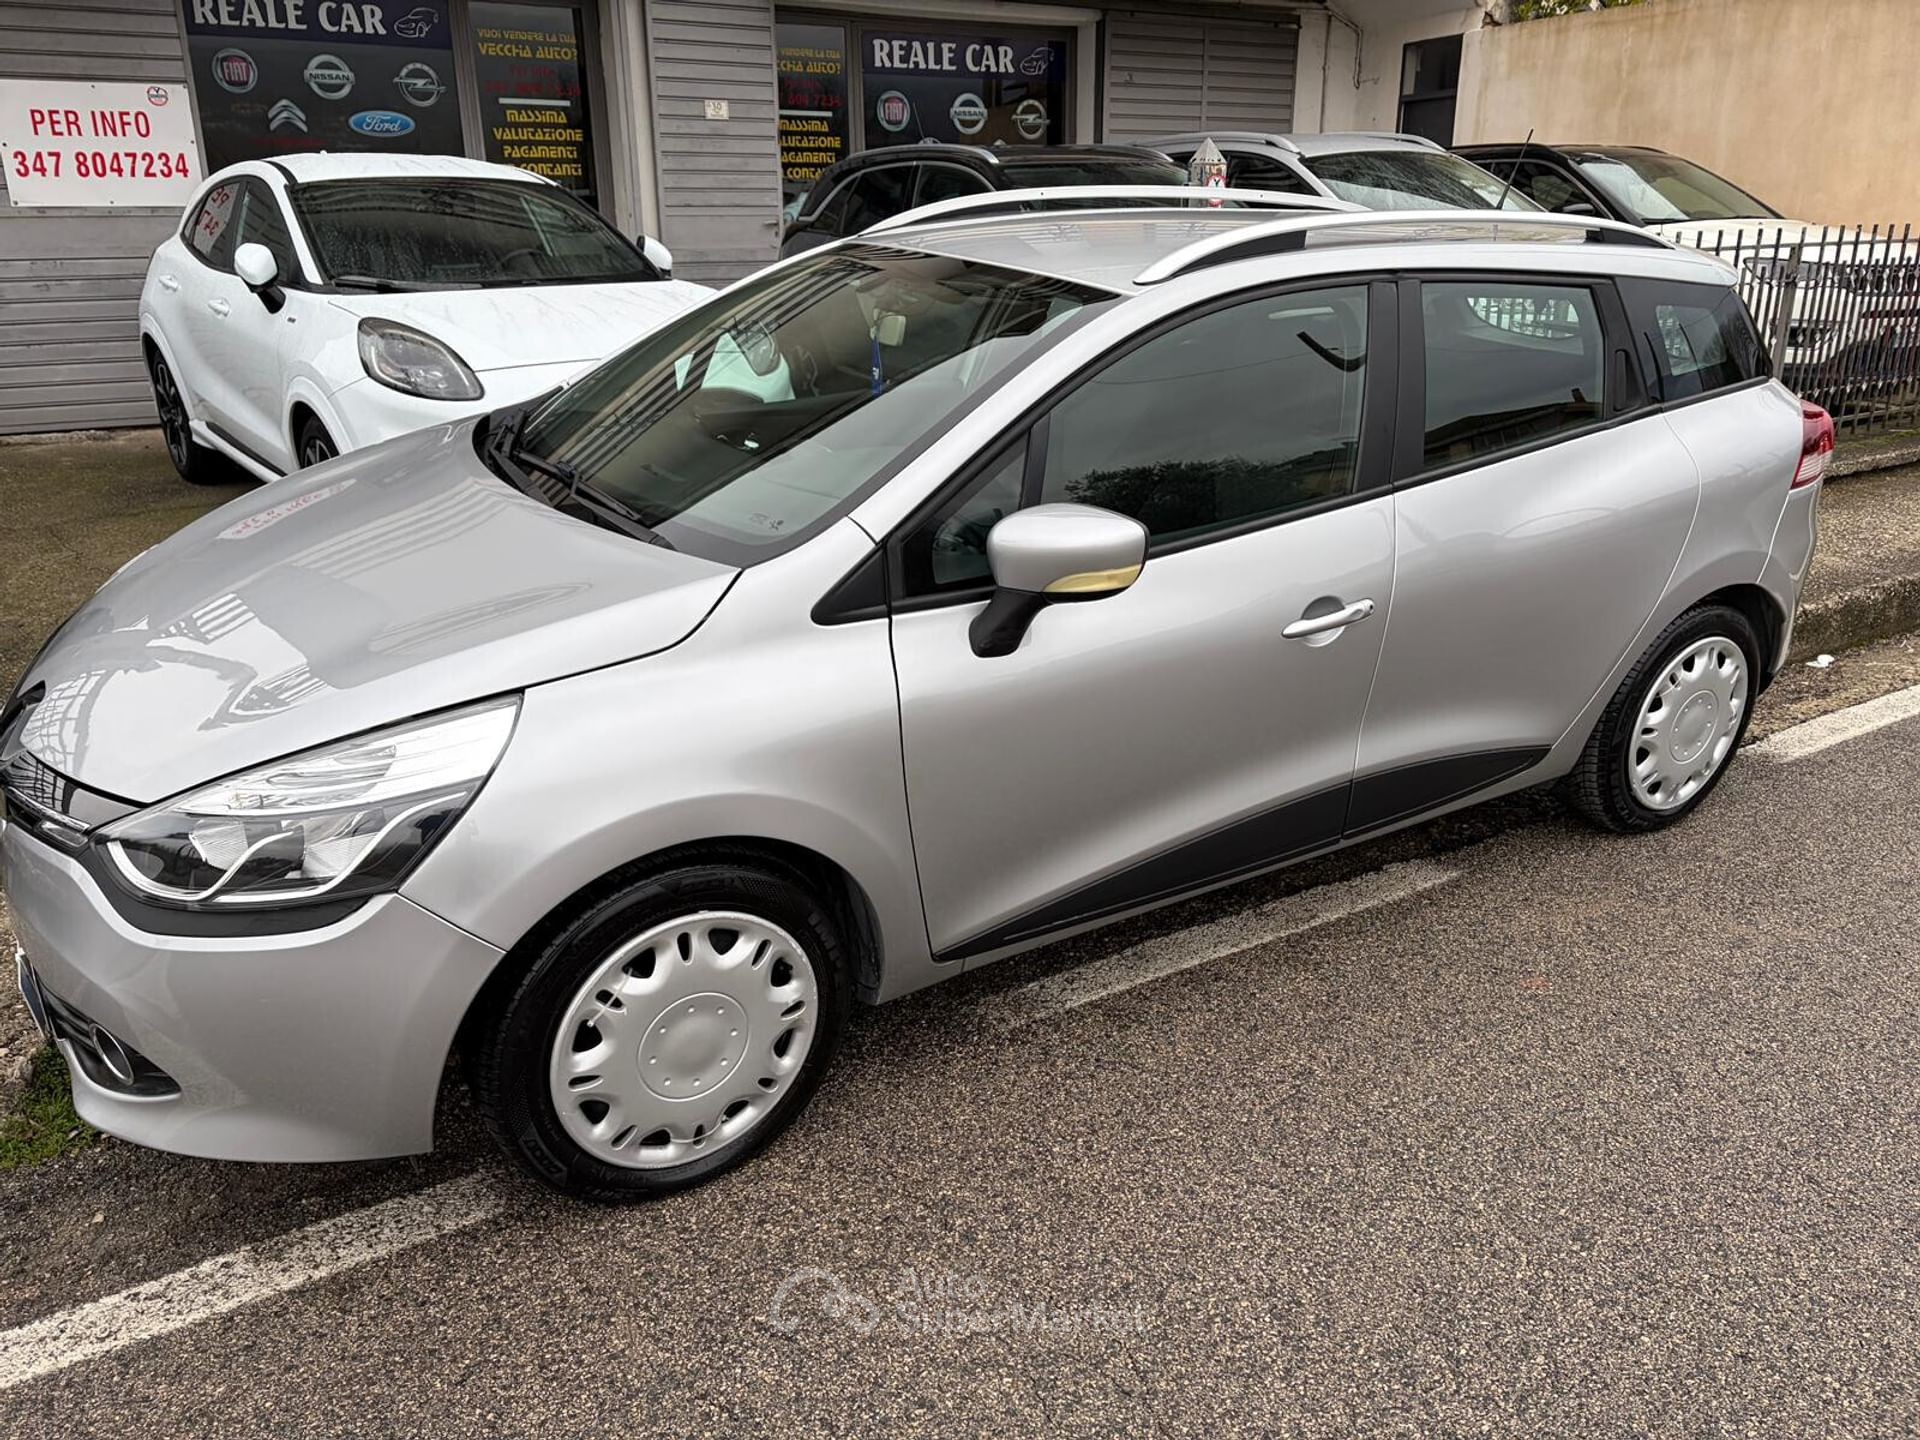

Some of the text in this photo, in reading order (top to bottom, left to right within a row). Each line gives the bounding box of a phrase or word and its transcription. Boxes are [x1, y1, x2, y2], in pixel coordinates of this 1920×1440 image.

[192, 0, 387, 35] REALE CAR
[503, 30, 545, 41] VENDERE
[546, 33, 559, 43] LA
[478, 42, 578, 60] VECCHIA AUTO?
[872, 38, 1015, 73] REALE CAR
[222, 61, 248, 83] FIAT
[807, 61, 841, 75] AUTO?
[309, 73, 351, 82] NISSAN
[505, 109, 568, 123] MASSIMA
[884, 101, 904, 121] FIAT
[953, 109, 985, 118] NISSAN
[29, 109, 151, 138] PER INFO
[363, 116, 401, 132] Ford
[492, 128, 584, 141] VALUTAZIONE
[503, 145, 577, 158] PAGAMENTI
[782, 151, 836, 164] AGAMENTI
[13, 151, 189, 178] 347 8047234
